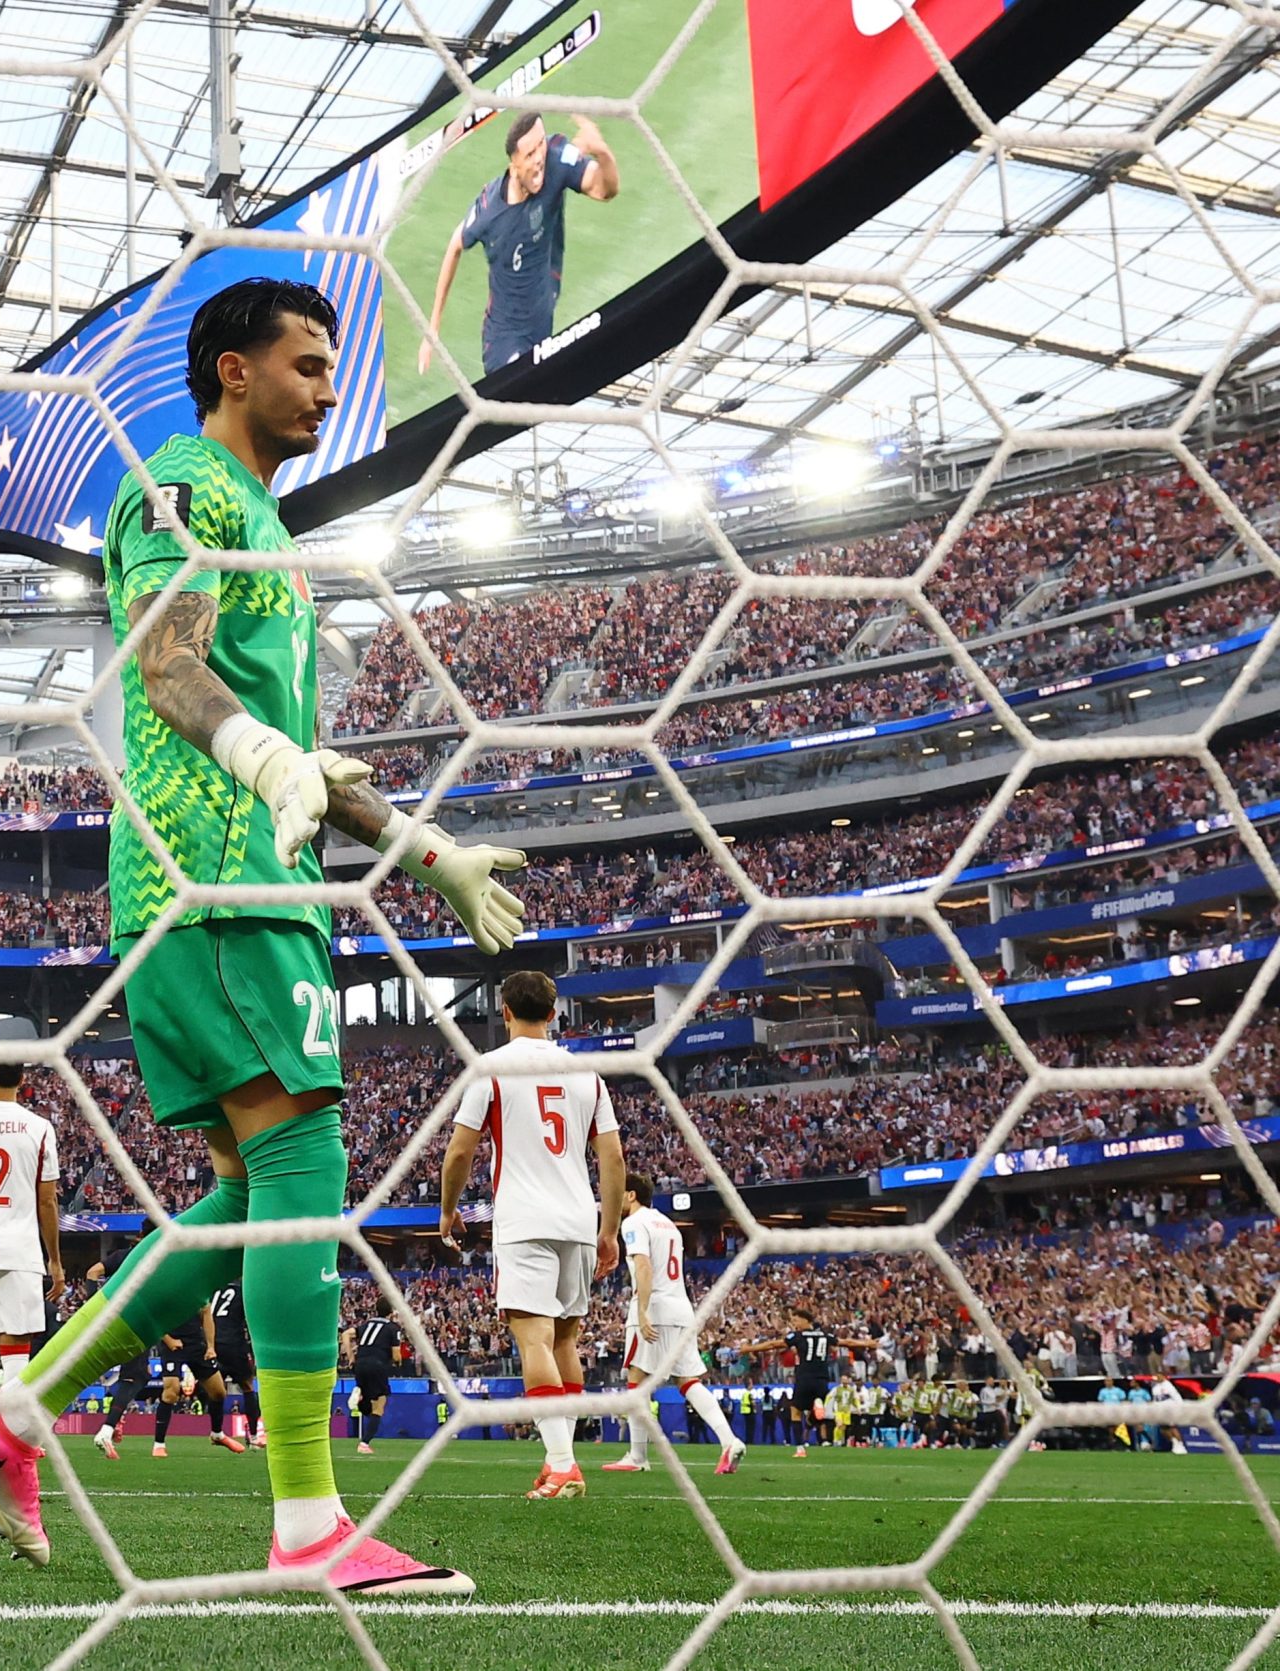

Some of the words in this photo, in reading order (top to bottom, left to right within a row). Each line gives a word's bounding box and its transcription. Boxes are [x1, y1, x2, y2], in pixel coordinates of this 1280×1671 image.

[512, 243, 523, 272] 6
[533, 311, 601, 365] Hisense
[535, 1085, 568, 1159] 5
[1103, 1141, 1128, 1157] LOS
[667, 1238, 680, 1281] 6
[210, 1288, 236, 1317] 12
[359, 1322, 384, 1346] 11
[806, 1337, 828, 1361] 14
